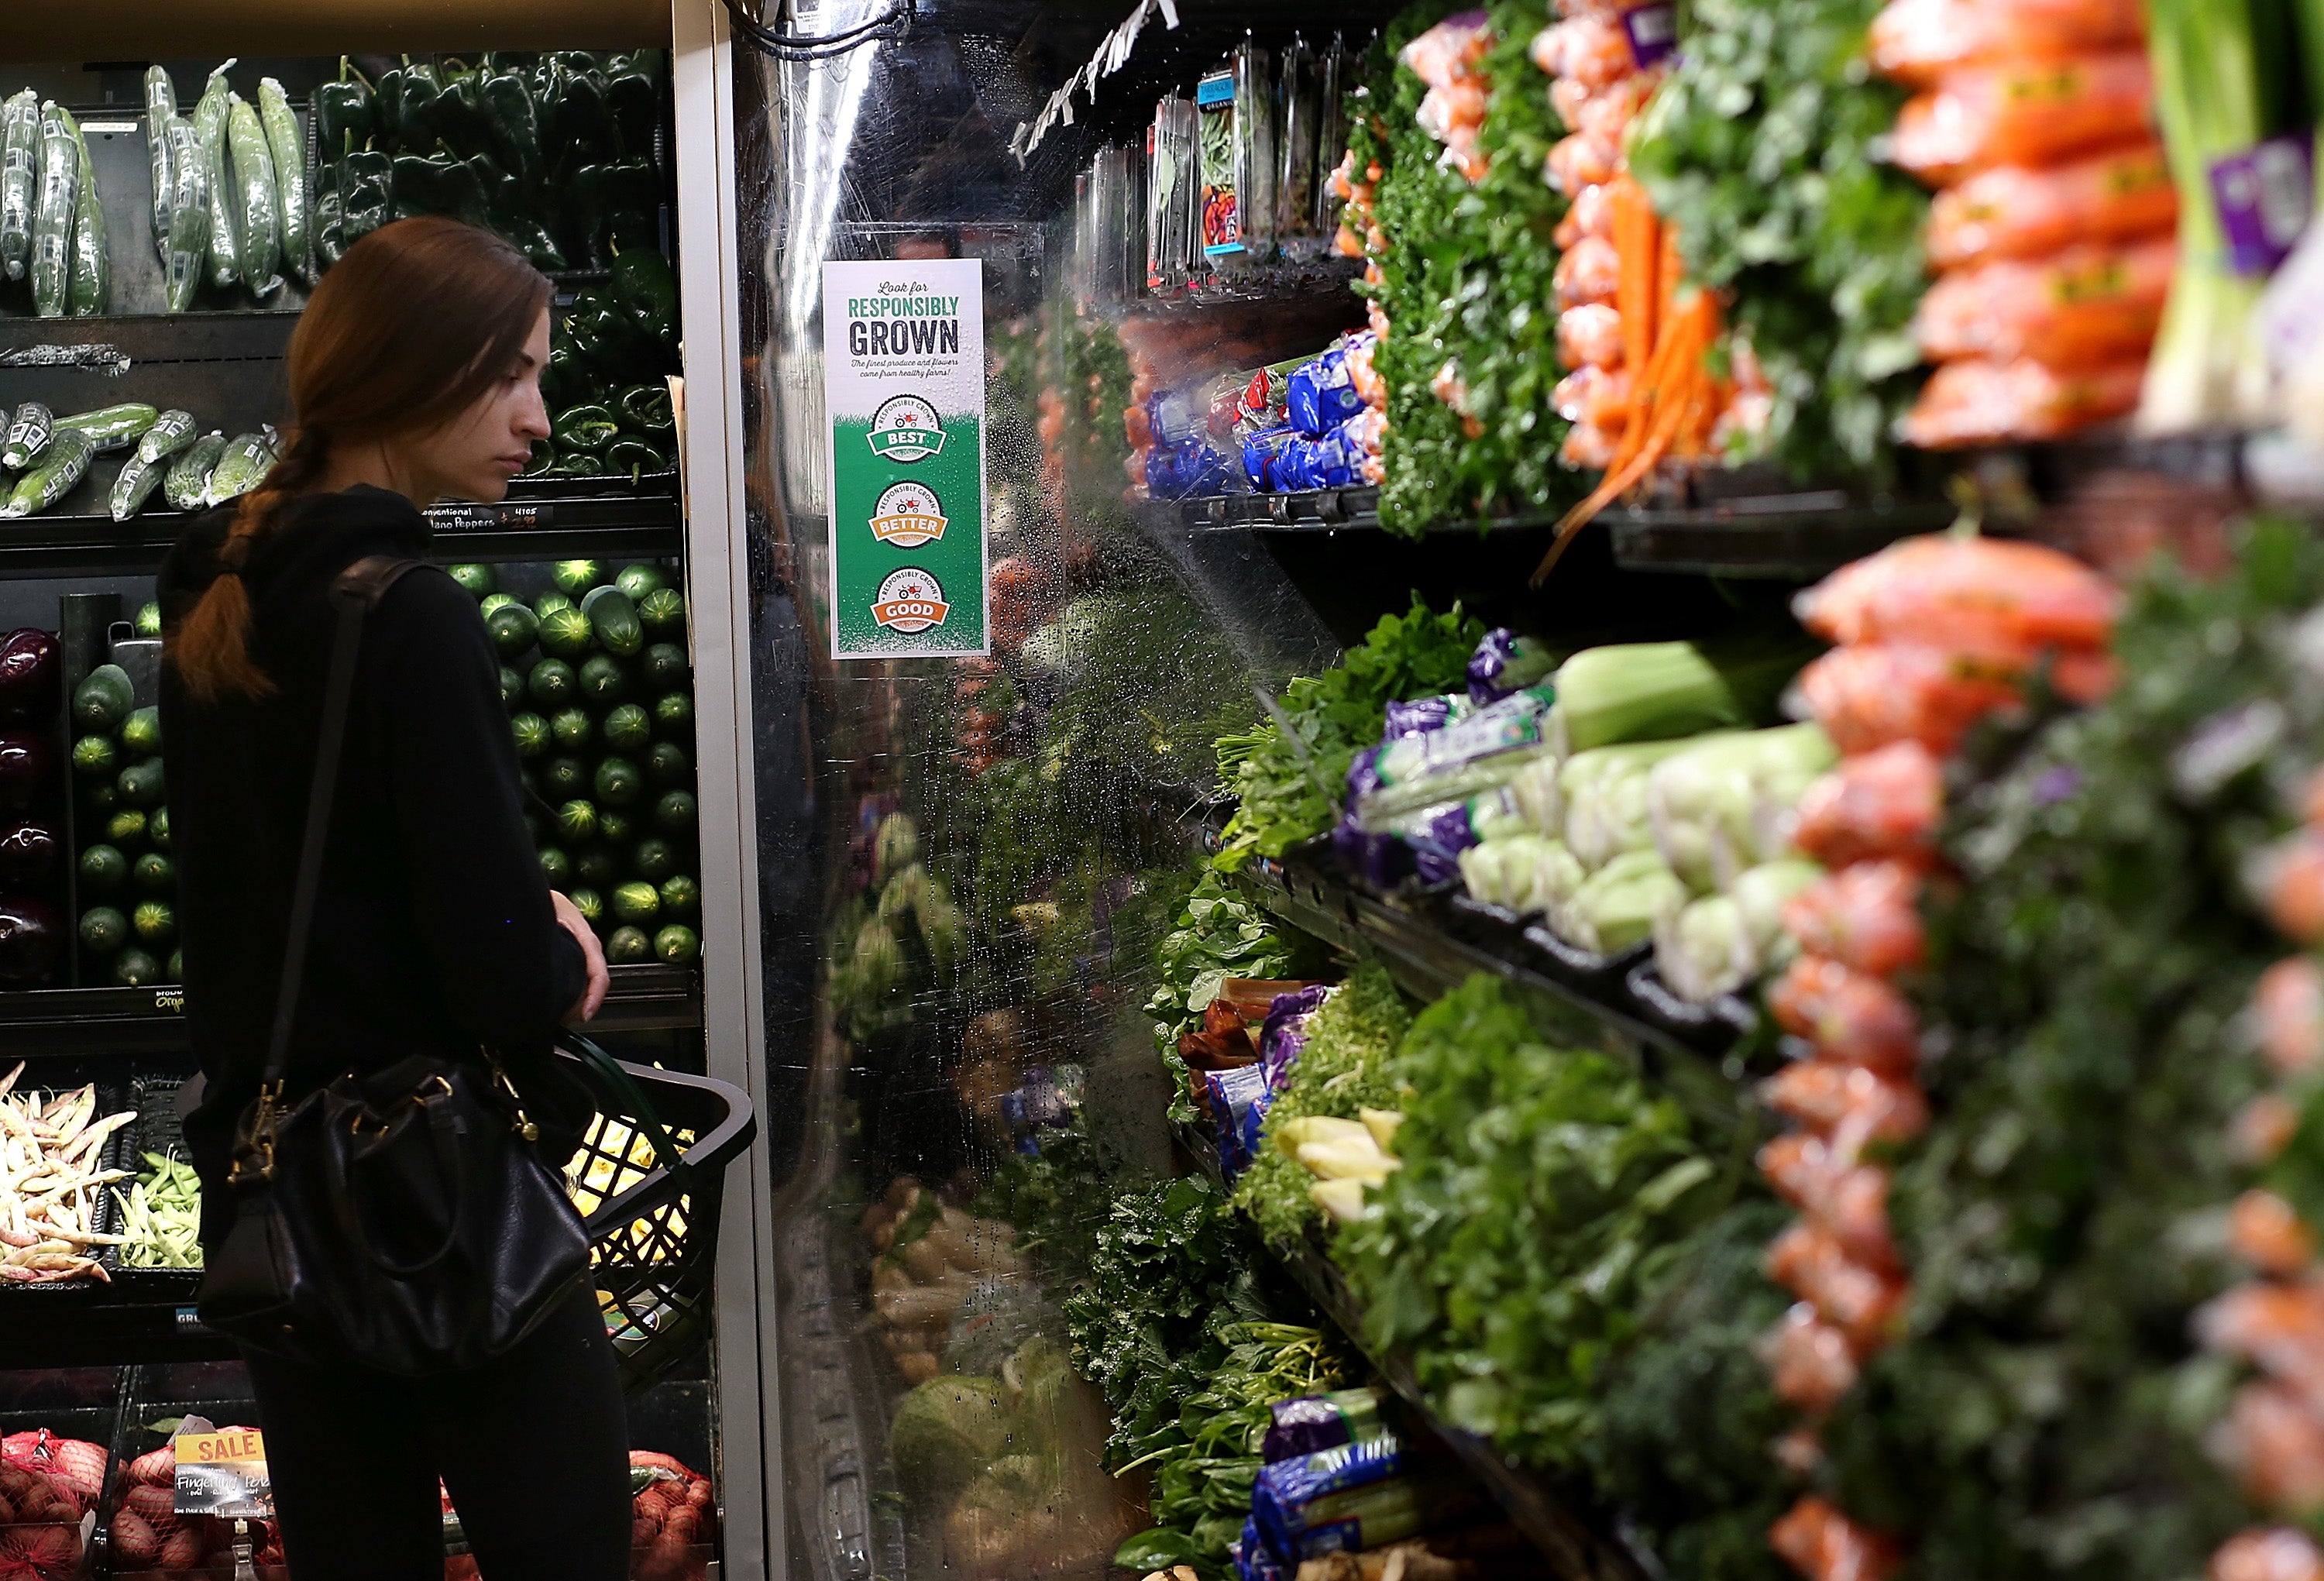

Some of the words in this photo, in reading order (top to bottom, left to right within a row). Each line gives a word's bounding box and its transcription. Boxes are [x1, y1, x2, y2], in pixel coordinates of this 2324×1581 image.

[878, 281, 909, 295] Look
[909, 281, 929, 296] for
[848, 297, 959, 318] RESPONSIBLY
[849, 319, 959, 356] GROWN
[851, 359, 865, 368] The
[865, 359, 886, 369] finest
[886, 359, 916, 368] produce
[916, 358, 931, 366] and
[930, 357, 959, 369] flowers
[878, 369, 898, 380] from
[898, 368, 925, 379] healthy
[925, 368, 951, 379] farms!
[878, 400, 916, 424] RESPONSIBLY
[916, 402, 934, 424] GROWN
[887, 431, 927, 445] BEST
[880, 485, 918, 510] RESPONSIBLY
[917, 488, 937, 509] GROWN
[421, 507, 472, 516] onventional
[455, 517, 495, 528] Peppers
[878, 517, 939, 534] BETTER
[882, 571, 919, 596] RESPONSIBLY
[919, 574, 938, 595] GROWN
[885, 603, 934, 617] GOOD
[198, 1434, 257, 1462] SALE
[177, 1476, 239, 1490] Fingerling
